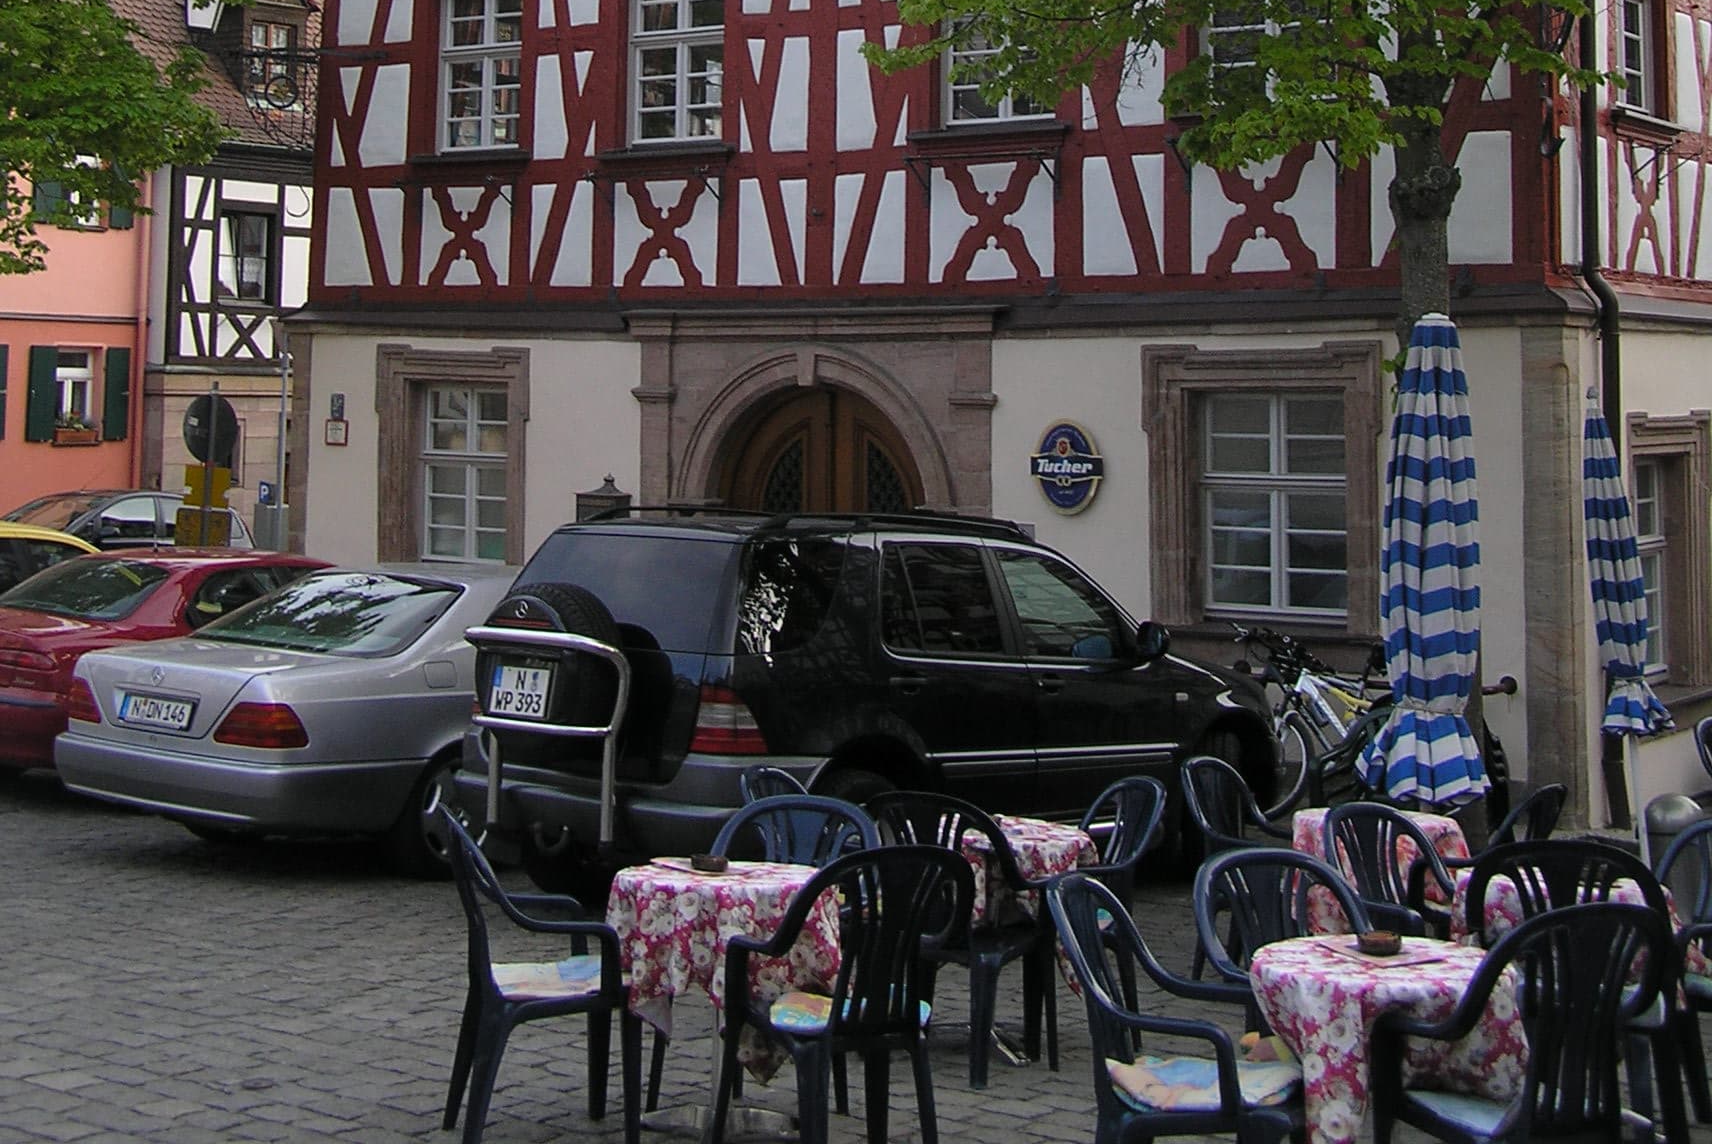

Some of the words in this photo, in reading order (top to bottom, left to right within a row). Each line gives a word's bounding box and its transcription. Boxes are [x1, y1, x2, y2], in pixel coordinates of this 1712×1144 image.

[1037, 458, 1093, 473] Tucher
[260, 484, 269, 499] P
[515, 670, 528, 690] N
[130, 698, 142, 716] N
[515, 692, 542, 714] 393
